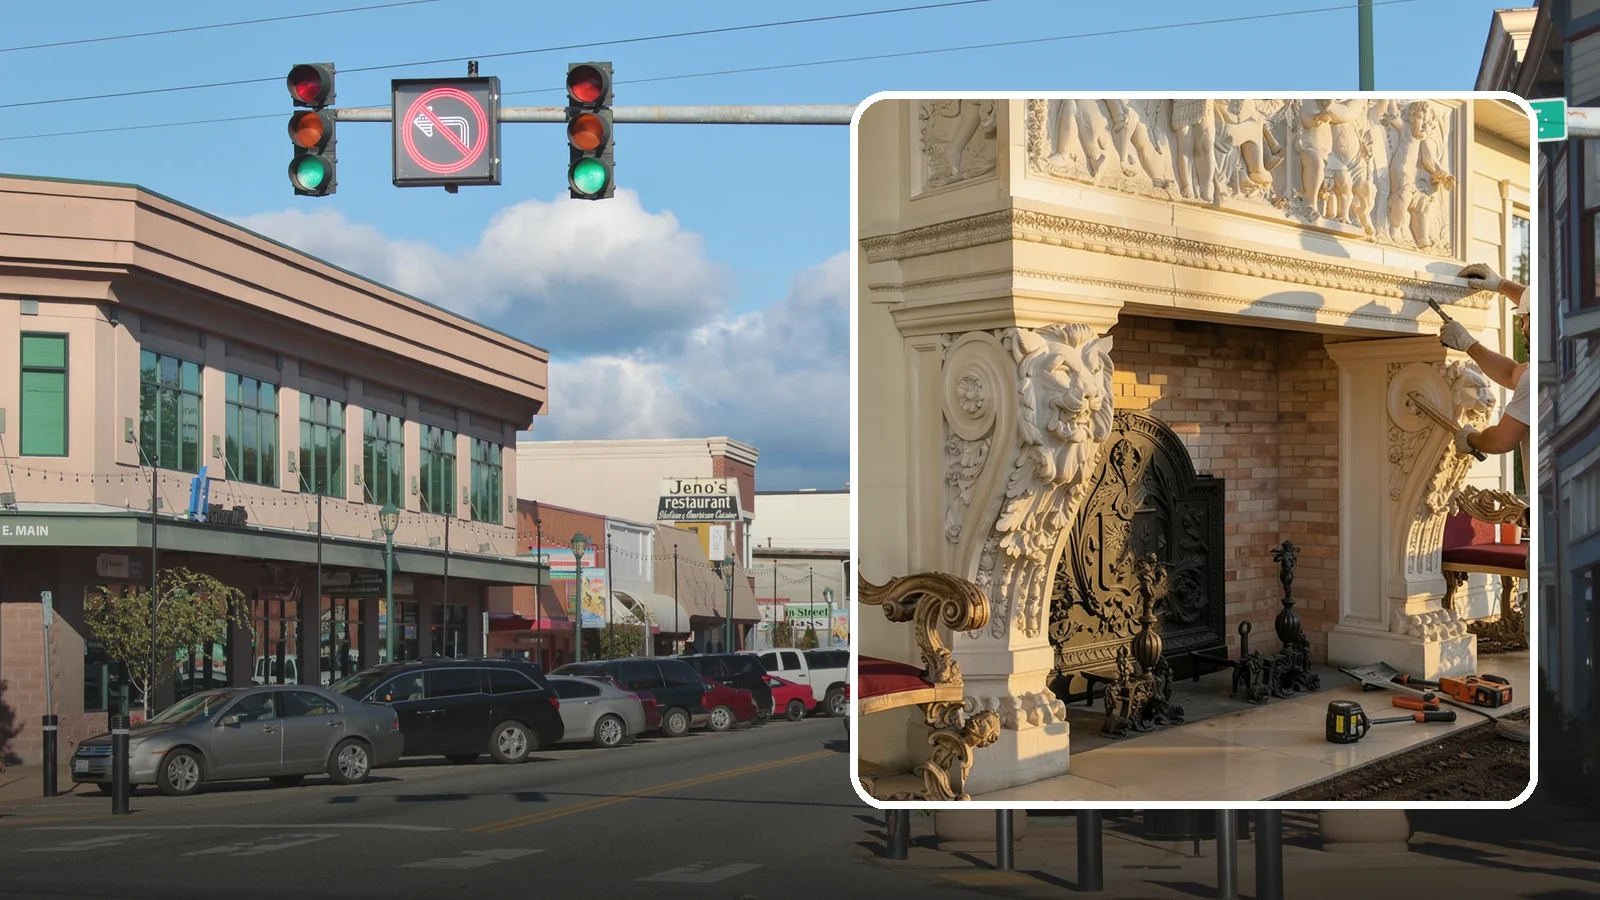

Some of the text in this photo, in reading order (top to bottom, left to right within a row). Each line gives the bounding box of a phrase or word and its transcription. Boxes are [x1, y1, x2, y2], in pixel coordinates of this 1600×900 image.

[669, 480, 728, 494] Jeno's
[665, 496, 731, 509] restaurant
[659, 510, 681, 519] Italian
[686, 509, 714, 519] American
[715, 509, 738, 519] Cuisine
[2, 525, 49, 536] E. MAIN
[797, 607, 829, 617] Street
[791, 618, 823, 627] lass
